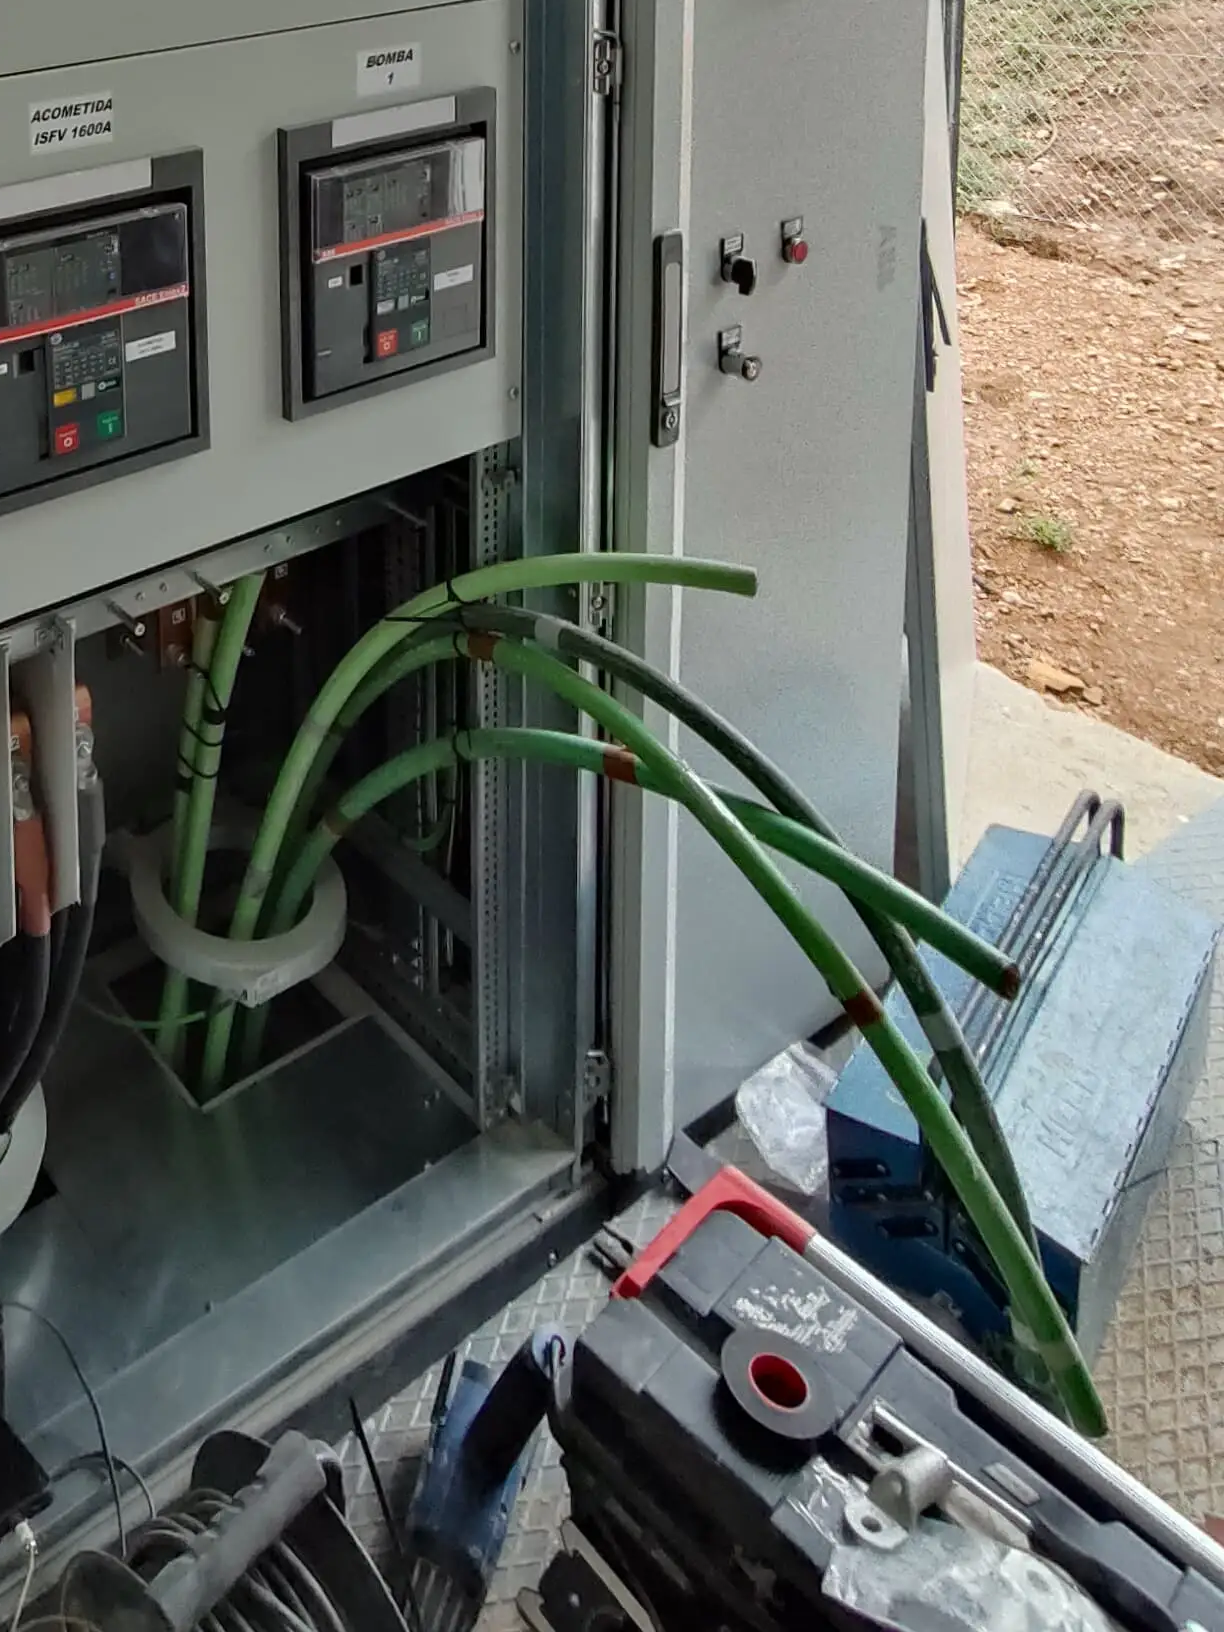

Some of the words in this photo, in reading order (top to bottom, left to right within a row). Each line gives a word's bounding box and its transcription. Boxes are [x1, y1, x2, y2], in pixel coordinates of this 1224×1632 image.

[366, 48, 413, 68] BOMBA
[387, 72, 394, 85] 1
[31, 98, 113, 124] ACOMETIDA
[34, 128, 68, 146] ISFV
[72, 121, 111, 139] 1600A
